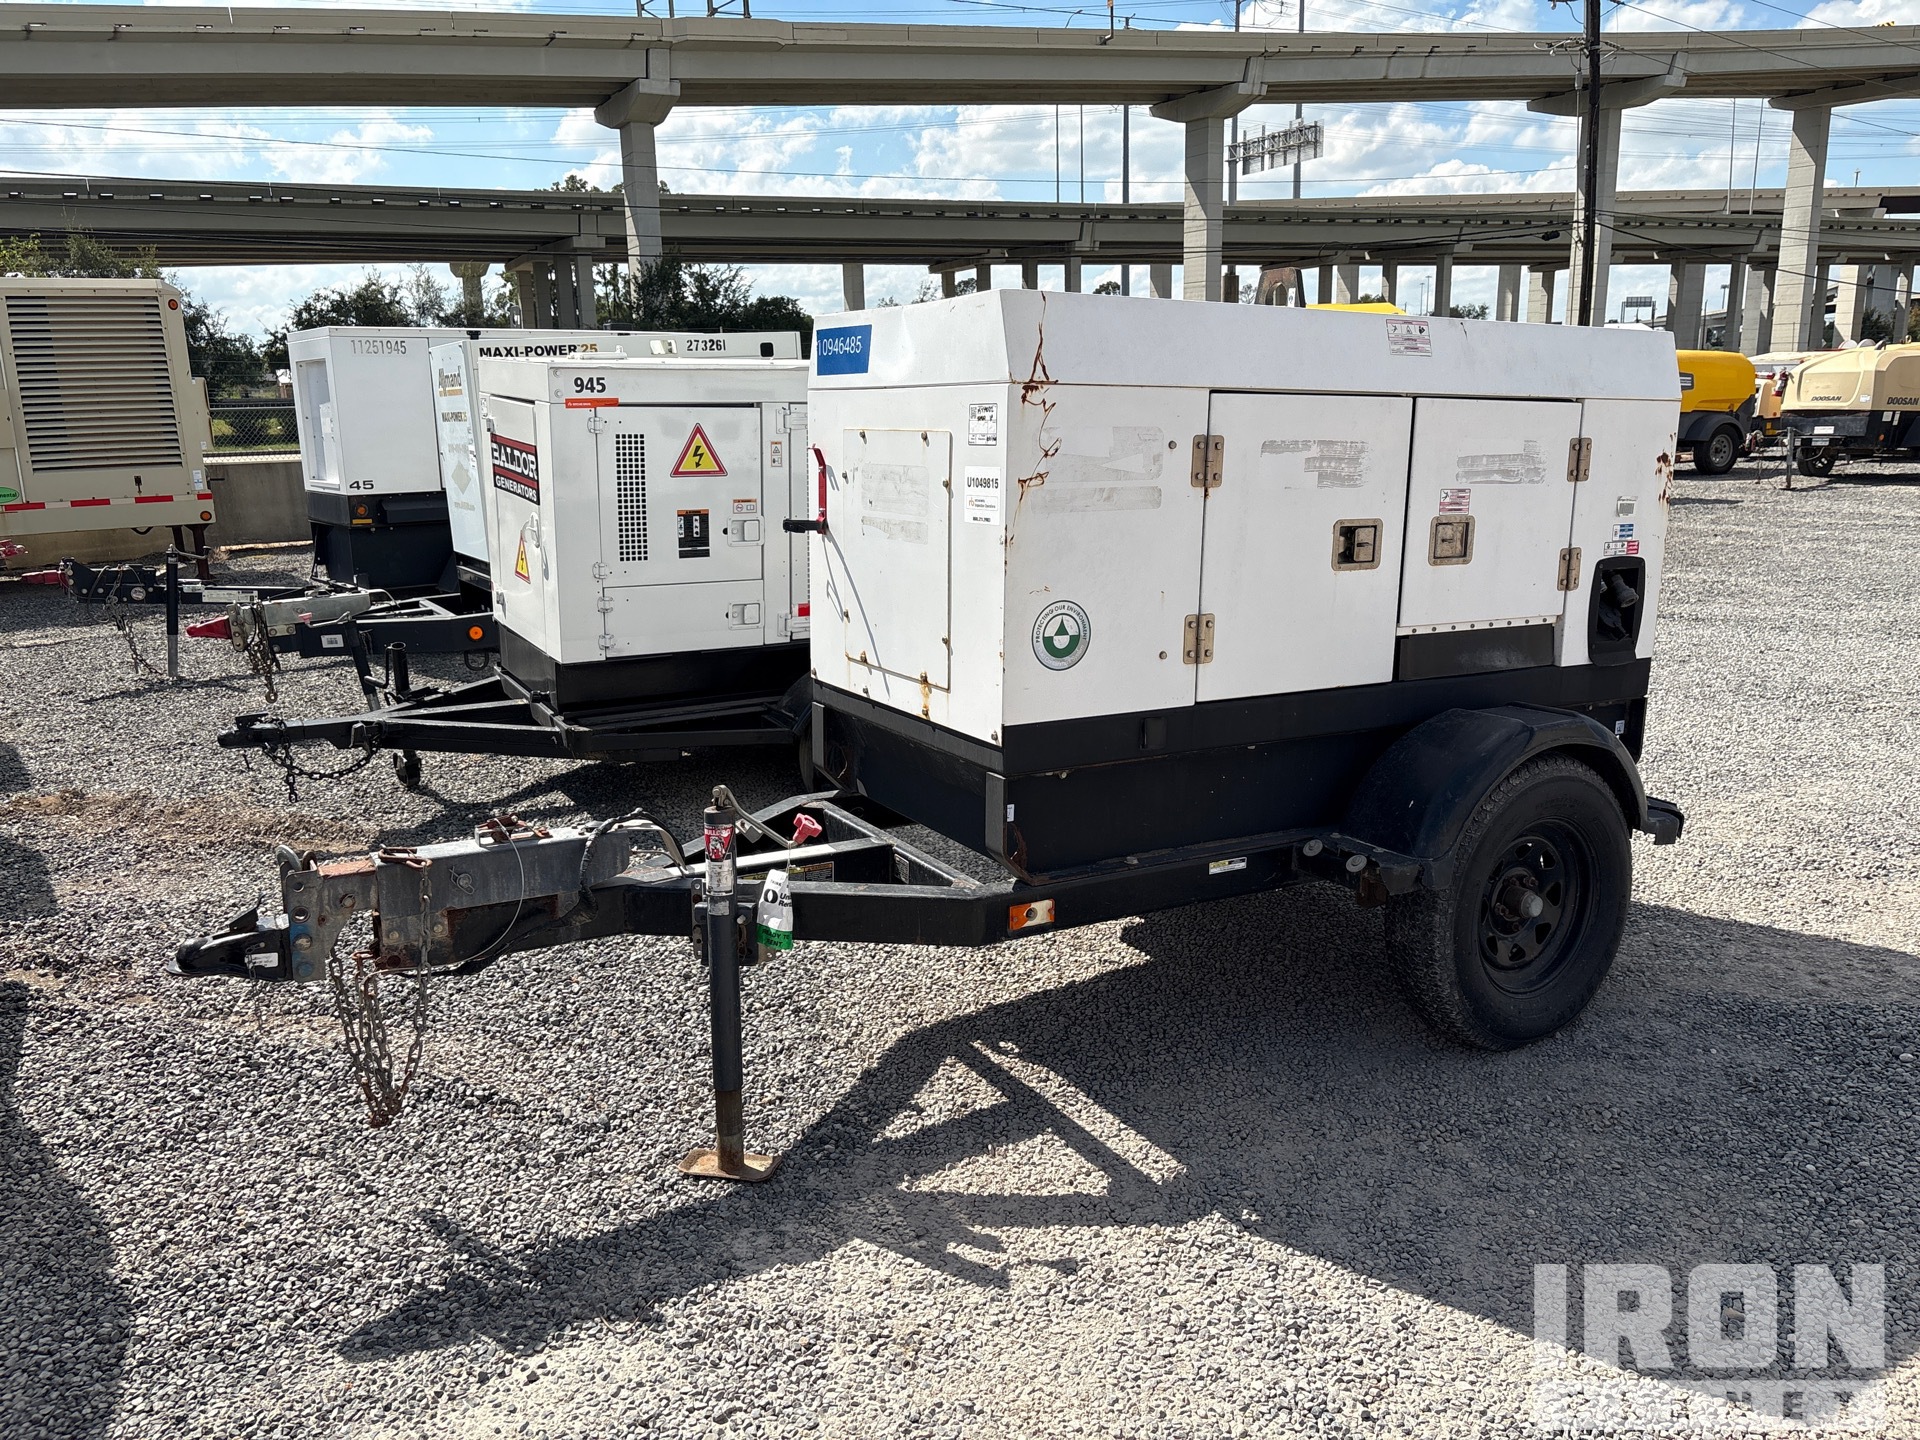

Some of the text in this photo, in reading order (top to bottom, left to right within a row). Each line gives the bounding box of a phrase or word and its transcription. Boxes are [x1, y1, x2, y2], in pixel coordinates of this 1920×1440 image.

[350, 339, 407, 355] 11251945
[479, 343, 598, 358] MAXI-POWER 25
[817, 335, 863, 357] 10946485
[573, 376, 607, 394] 945
[1886, 396, 1920, 406] DOOSAN
[491, 442, 538, 481] BALDOR
[349, 479, 375, 491] 45
[495, 475, 537, 502] GENERATORS
[966, 476, 999, 489] U1049815
[1035, 604, 1088, 643] PROTECTING OUR ENVIRONMENT
